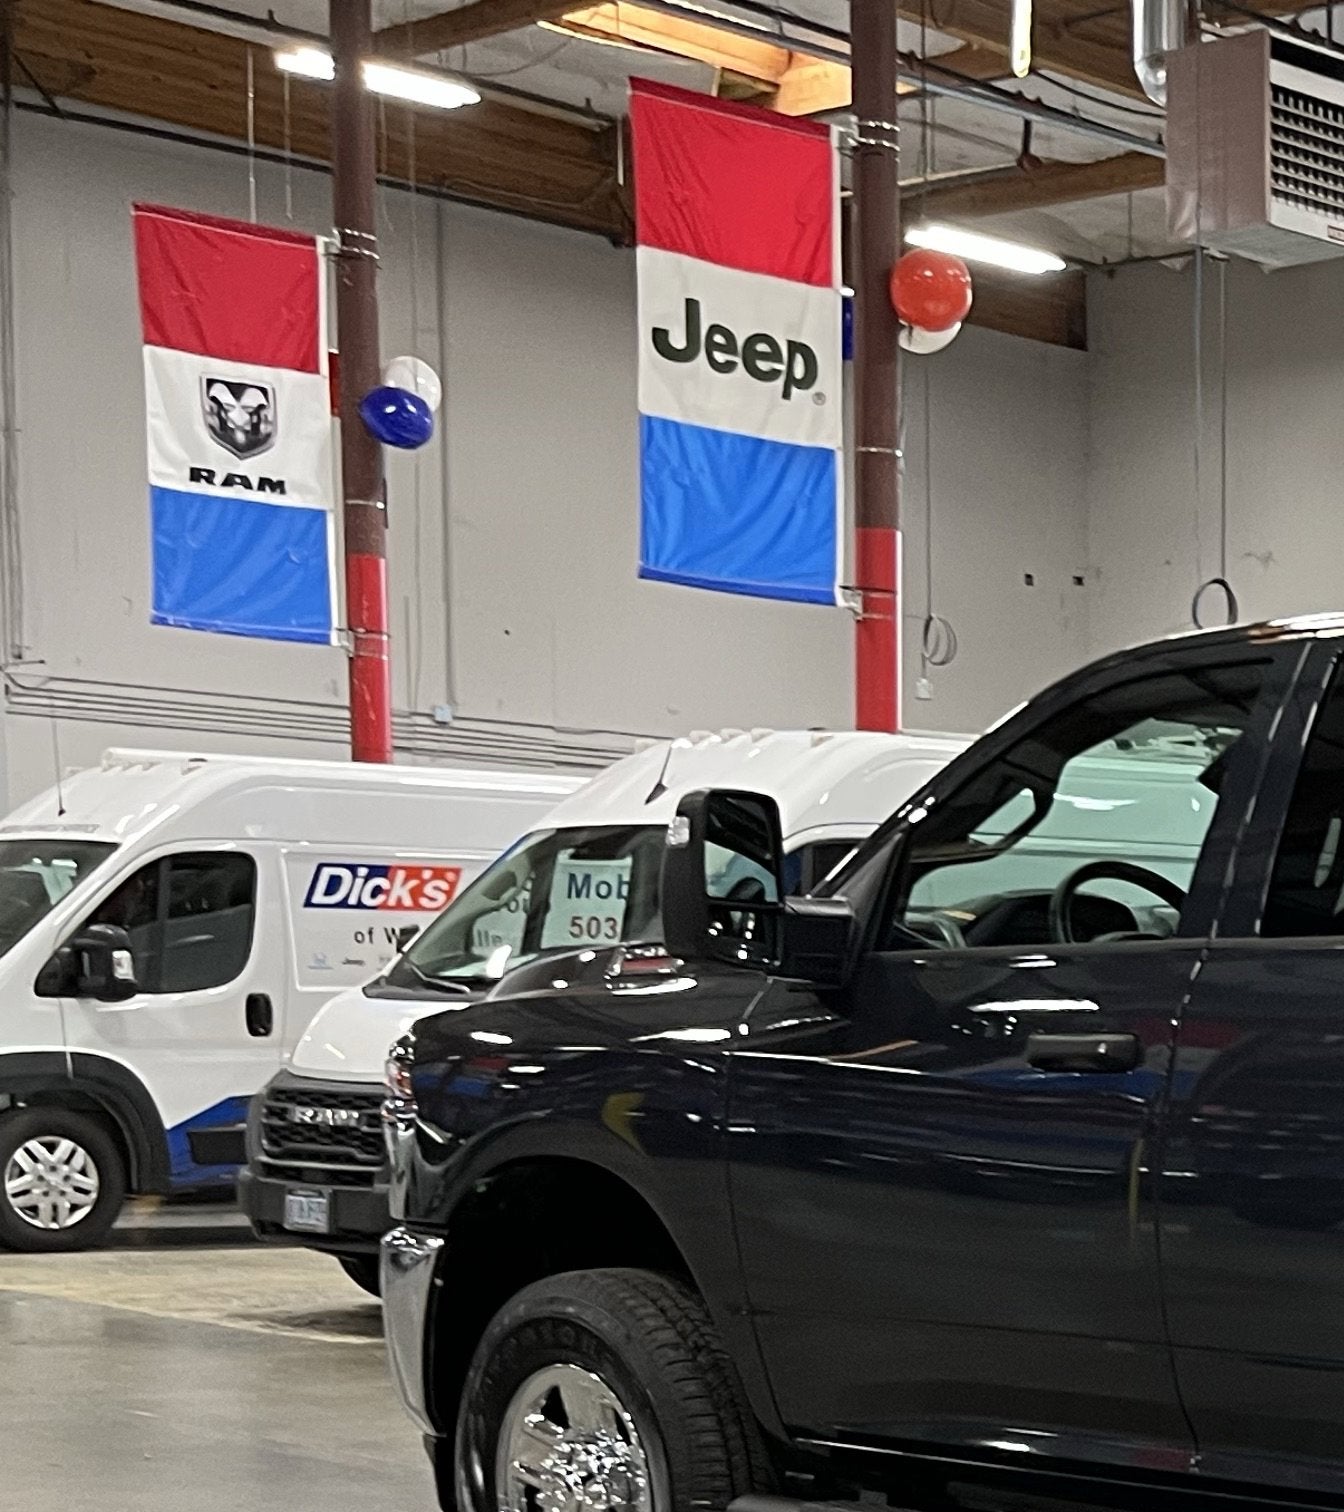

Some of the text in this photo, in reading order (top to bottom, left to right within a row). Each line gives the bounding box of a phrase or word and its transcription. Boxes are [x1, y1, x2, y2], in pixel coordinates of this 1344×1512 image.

[651, 297, 818, 401] Jeep
[189, 466, 286, 495] RAM
[311, 866, 450, 909] Dick's
[354, 926, 374, 944] of
[569, 916, 617, 939] 503
